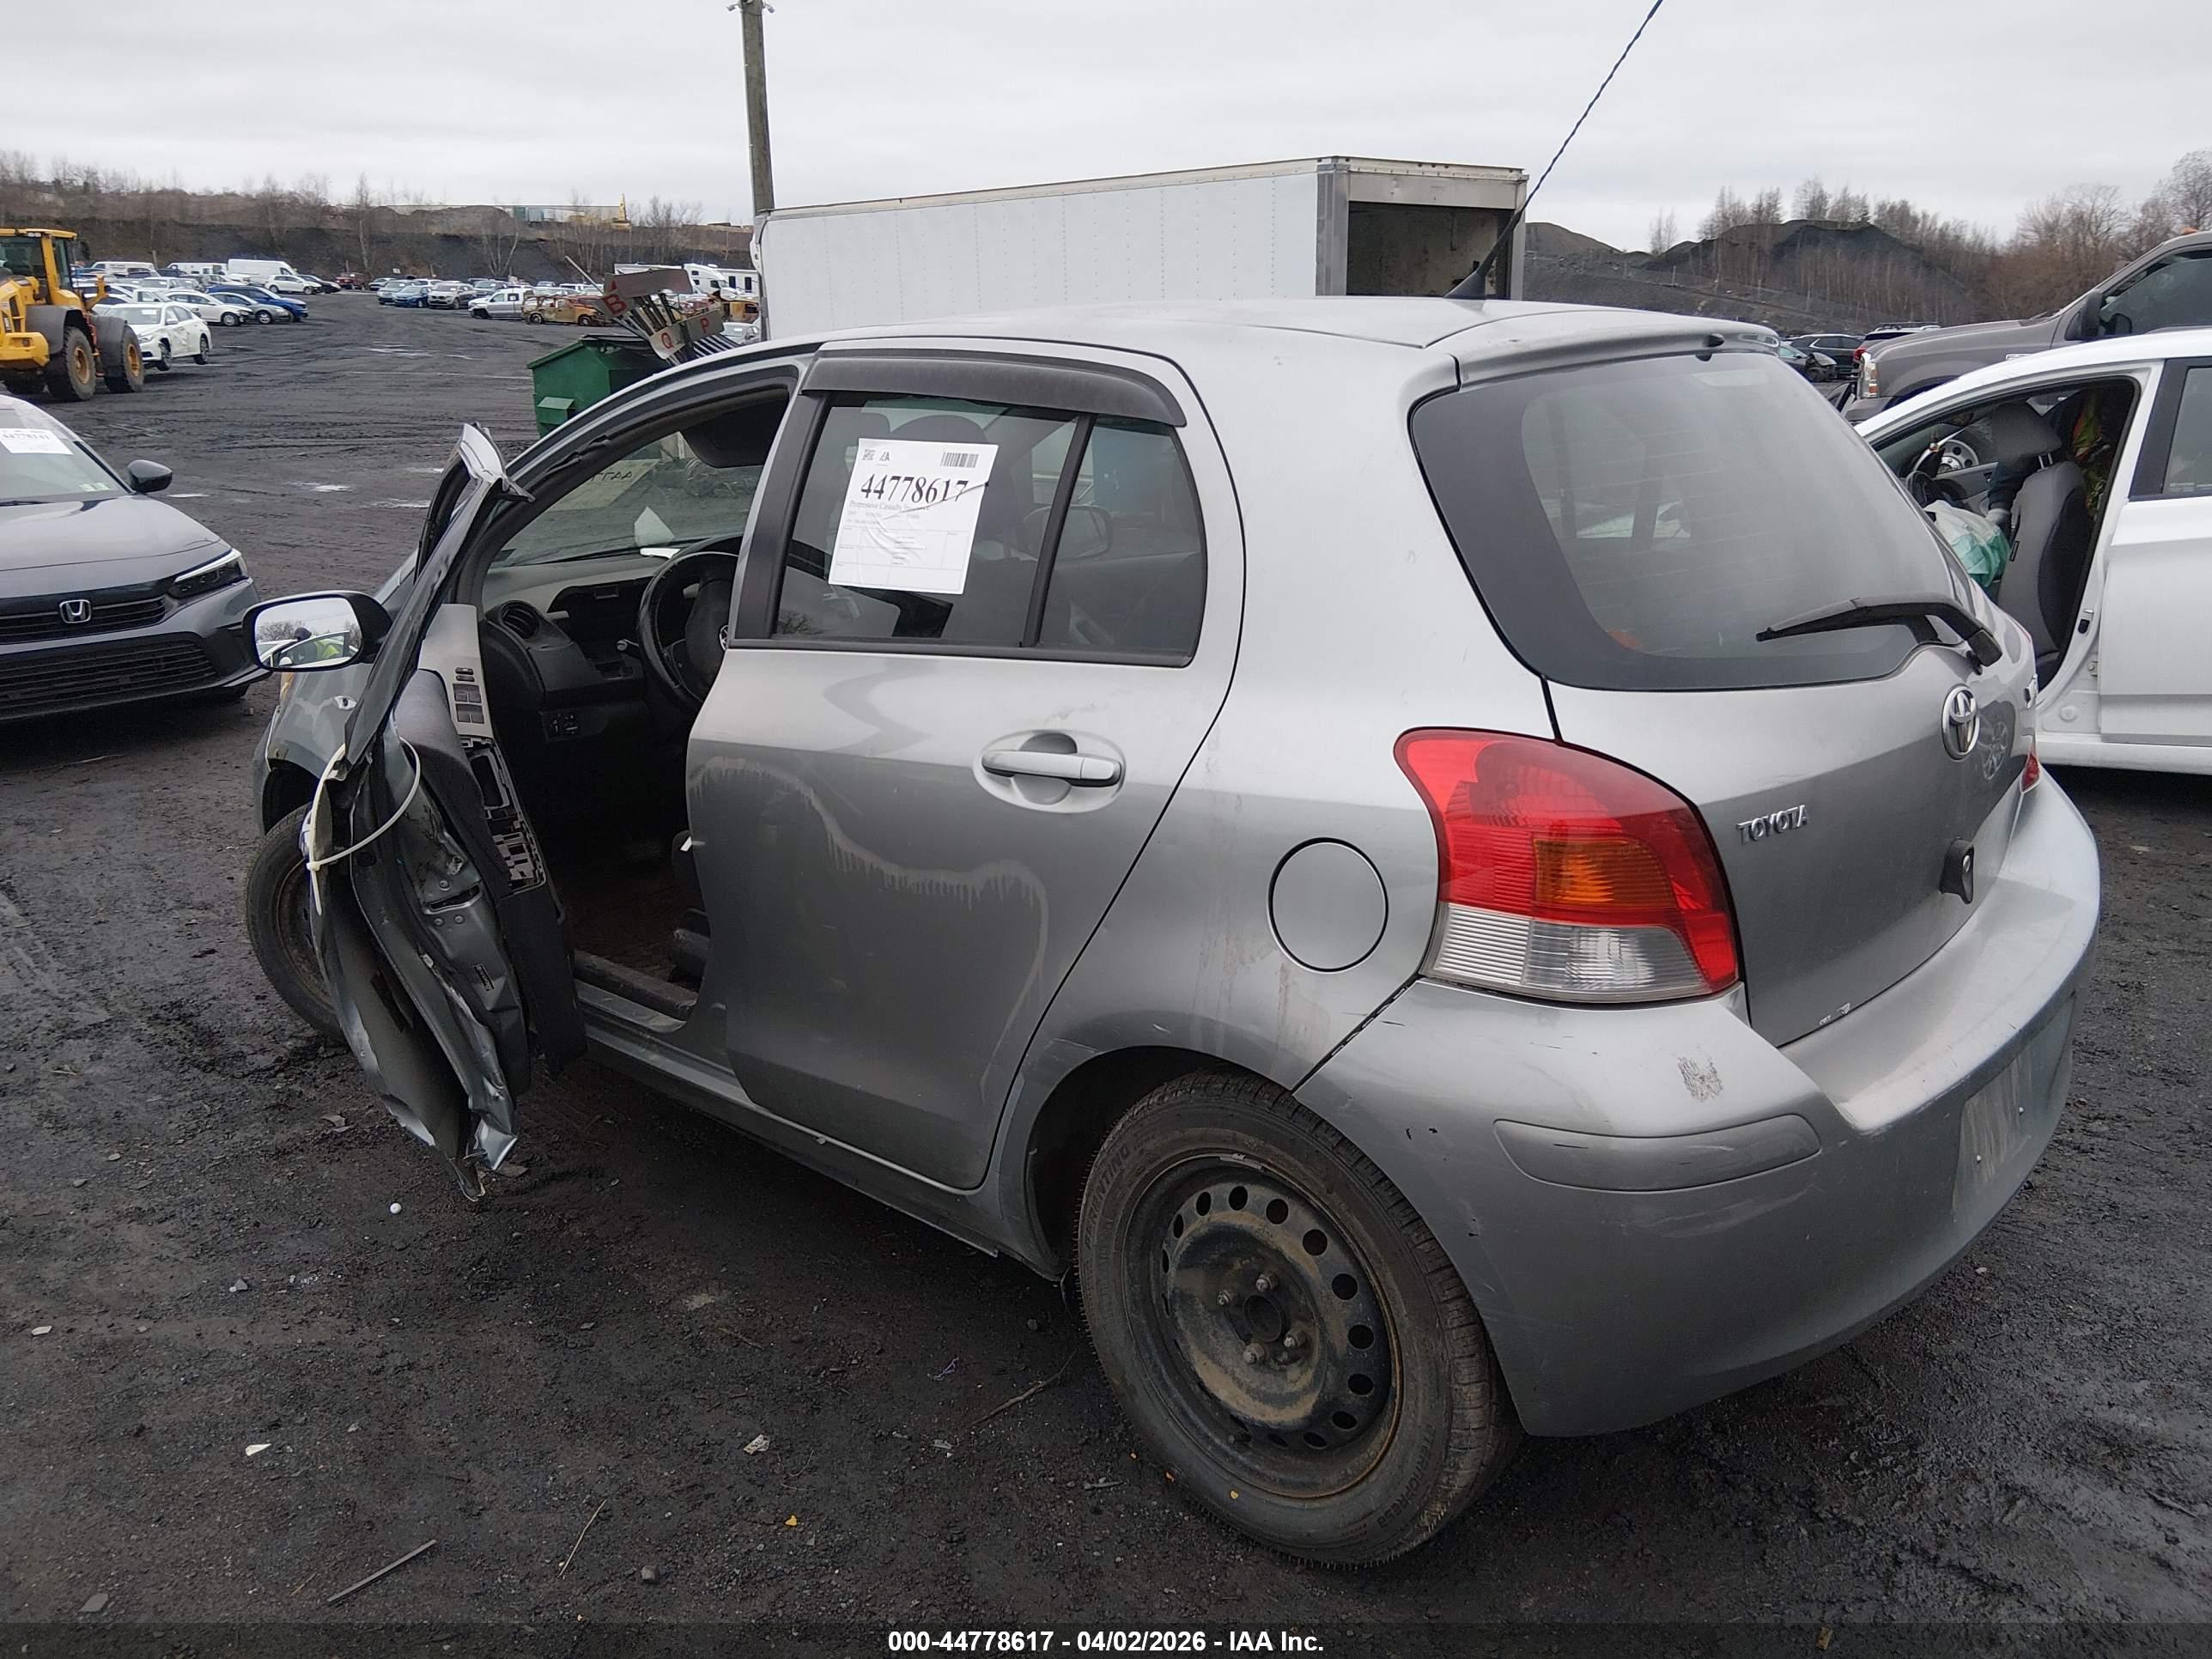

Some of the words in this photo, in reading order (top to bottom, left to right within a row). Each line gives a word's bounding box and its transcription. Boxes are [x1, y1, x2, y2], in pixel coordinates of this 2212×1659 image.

[603, 294, 628, 316] B
[700, 318, 709, 333] P
[660, 332, 674, 349] Q
[860, 474, 969, 503] 44778617
[1736, 804, 1808, 845] TOYOTA
